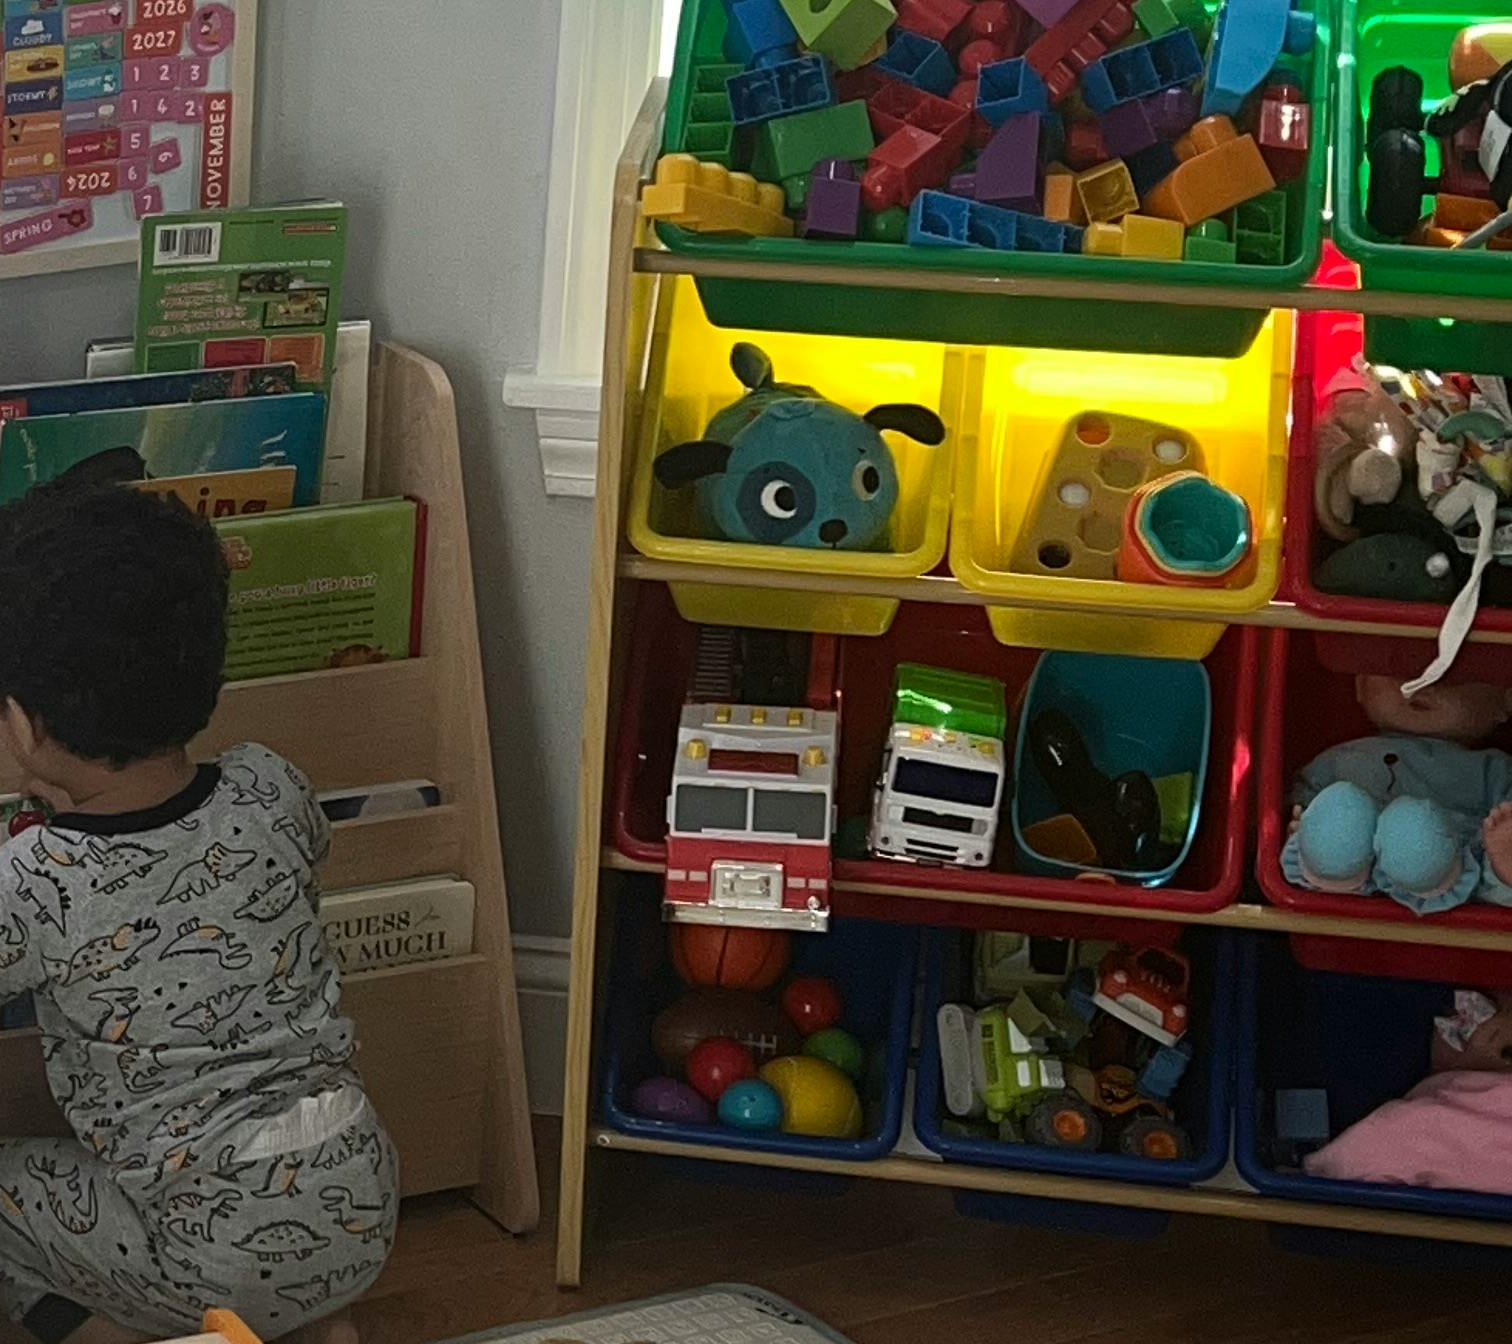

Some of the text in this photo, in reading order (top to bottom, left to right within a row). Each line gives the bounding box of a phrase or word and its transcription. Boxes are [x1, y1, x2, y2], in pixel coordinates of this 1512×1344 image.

[12, 34, 53, 47] CLOUDY
[133, 30, 176, 50] 2027
[133, 65, 201, 83] 1 2 3
[7, 90, 46, 104] STORMY
[131, 98, 196, 117] 1 4 2
[130, 133, 141, 149] 5
[205, 98, 227, 209] NOVEMBER
[67, 172, 111, 190] 2024
[127, 165, 138, 181] 6
[143, 194, 153, 210] 7
[3, 219, 53, 245] SPRING
[323, 910, 411, 940] GUESS
[360, 930, 446, 962] MUCH
